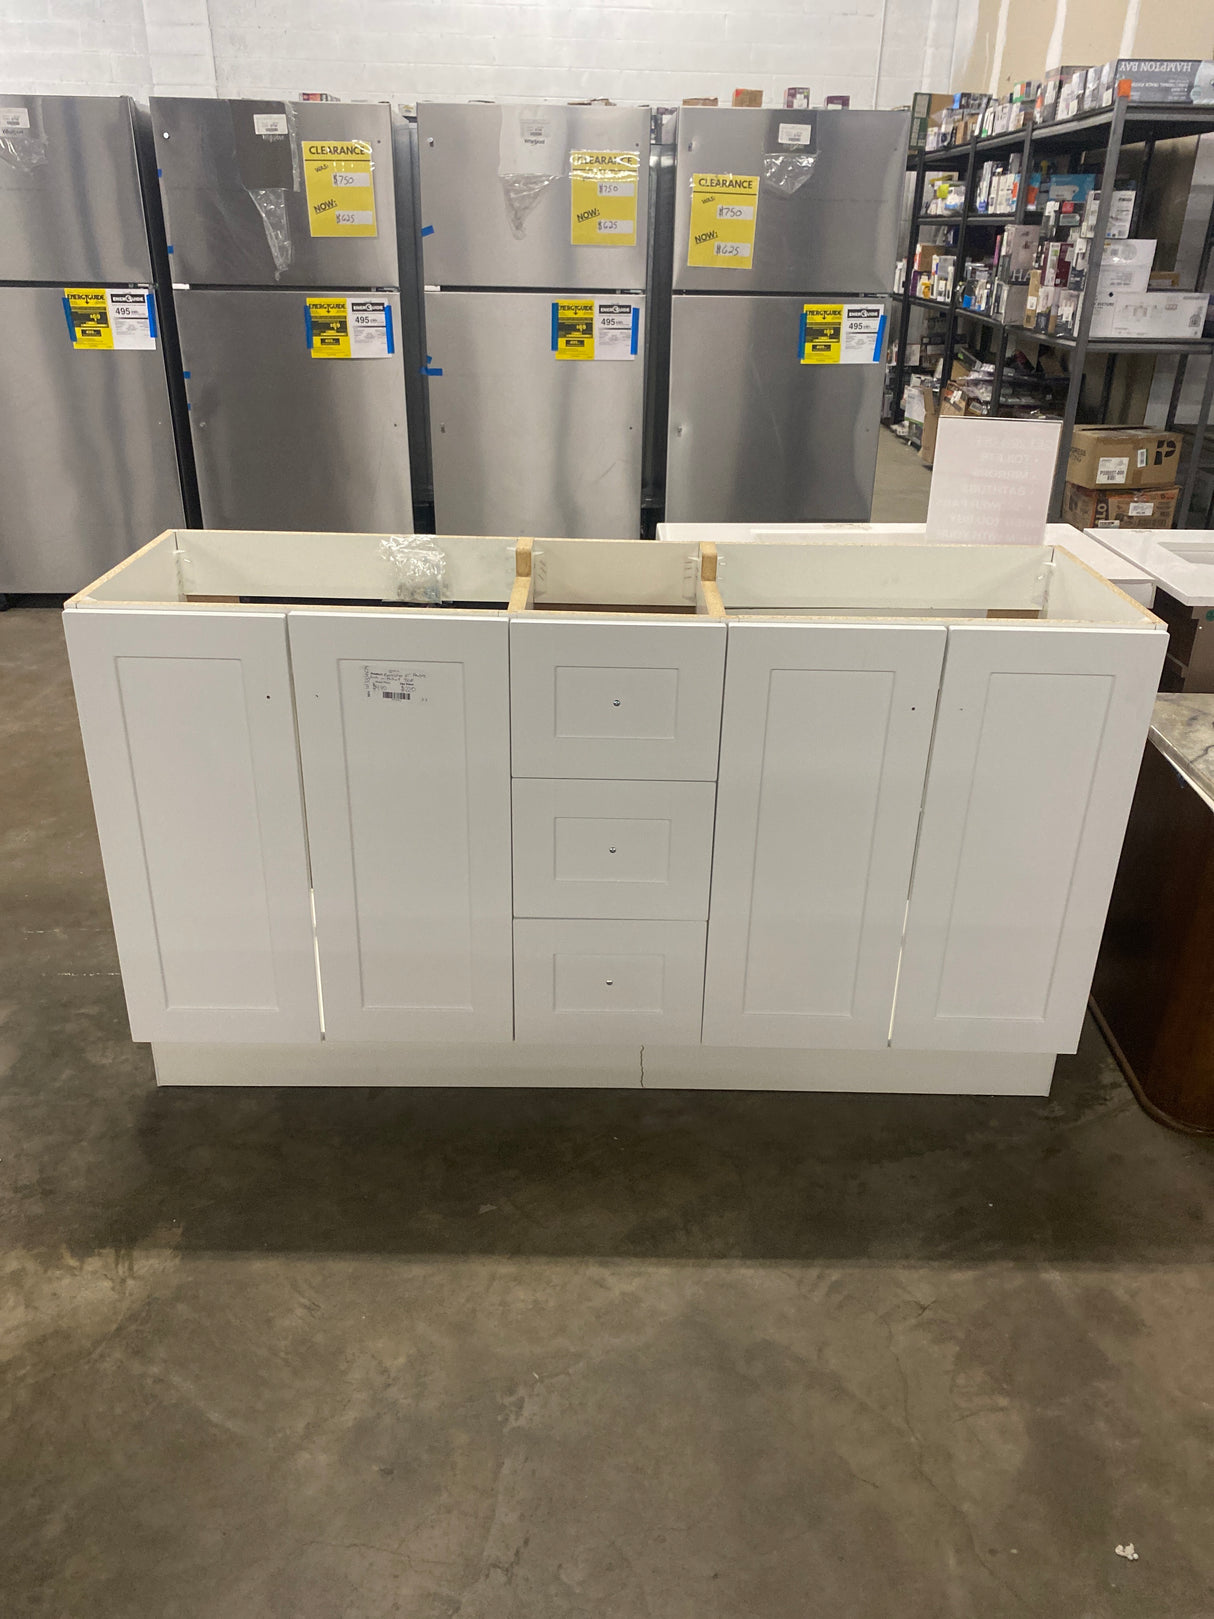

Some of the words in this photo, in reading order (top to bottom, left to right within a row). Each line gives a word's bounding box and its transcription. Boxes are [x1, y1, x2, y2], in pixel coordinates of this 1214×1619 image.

[1119, 61, 1139, 72] BAY
[1140, 61, 1192, 72] HAMPTON
[308, 145, 366, 155] CLEARANCE
[332, 173, 354, 186] $750
[698, 177, 753, 189] CLEARANCE
[598, 183, 619, 194] $750
[313, 198, 338, 214] NOW:
[576, 208, 600, 223] NOW:
[718, 206, 743, 218] $750
[694, 229, 719, 244] NOW:
[715, 245, 739, 256] $625
[1011, 268, 1032, 281] HA
[115, 307, 131, 315] 495
[355, 316, 370, 324] 495
[600, 318, 616, 326] 495
[848, 322, 864, 330] 495
